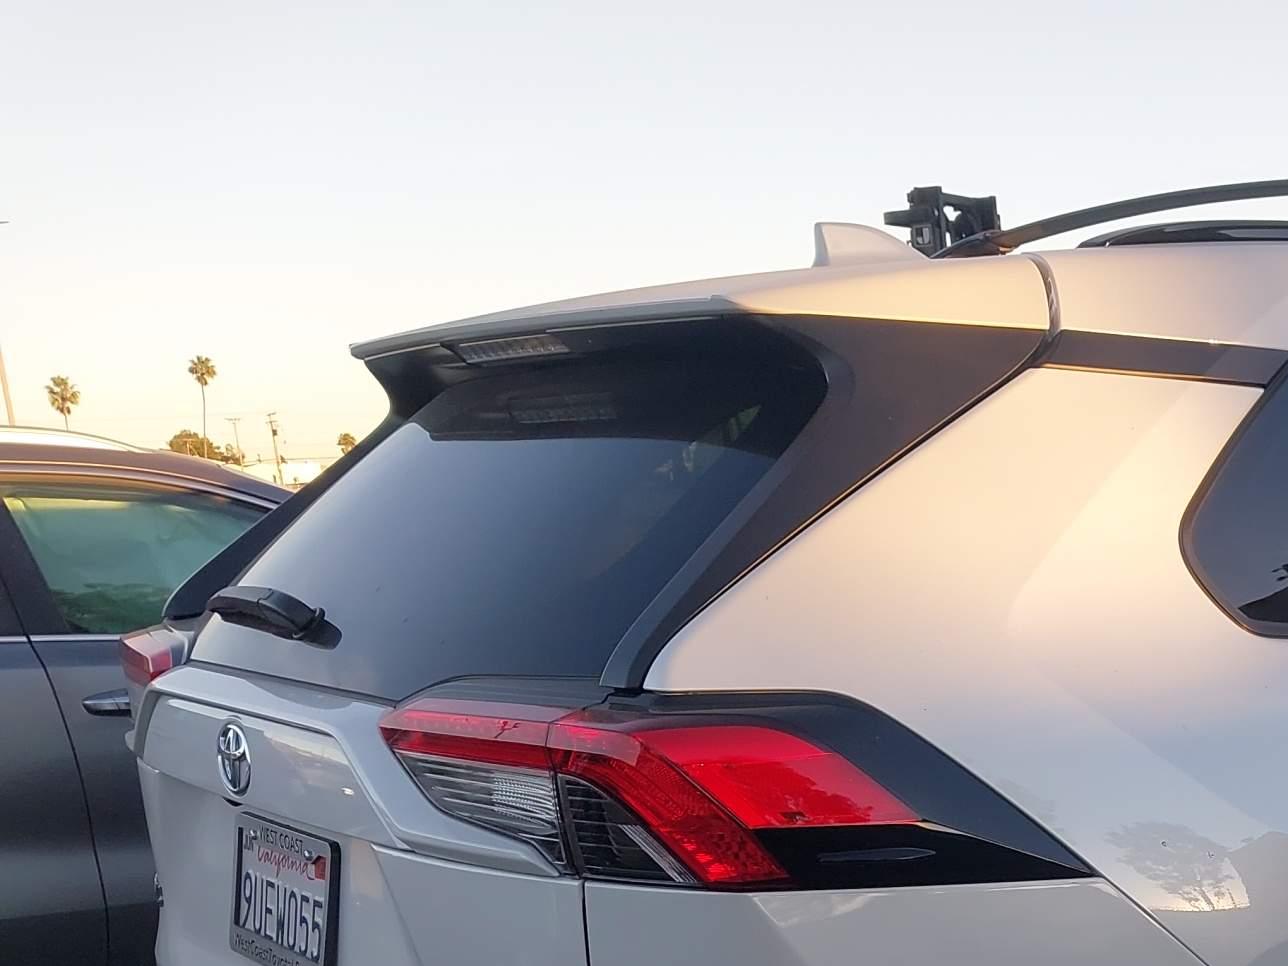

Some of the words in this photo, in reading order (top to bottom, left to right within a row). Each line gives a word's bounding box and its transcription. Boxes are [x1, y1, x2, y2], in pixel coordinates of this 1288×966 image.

[258, 825, 278, 844] WEST
[279, 833, 304, 855] COAST
[257, 846, 315, 880] California
[241, 870, 323, 963] 9UEW055
